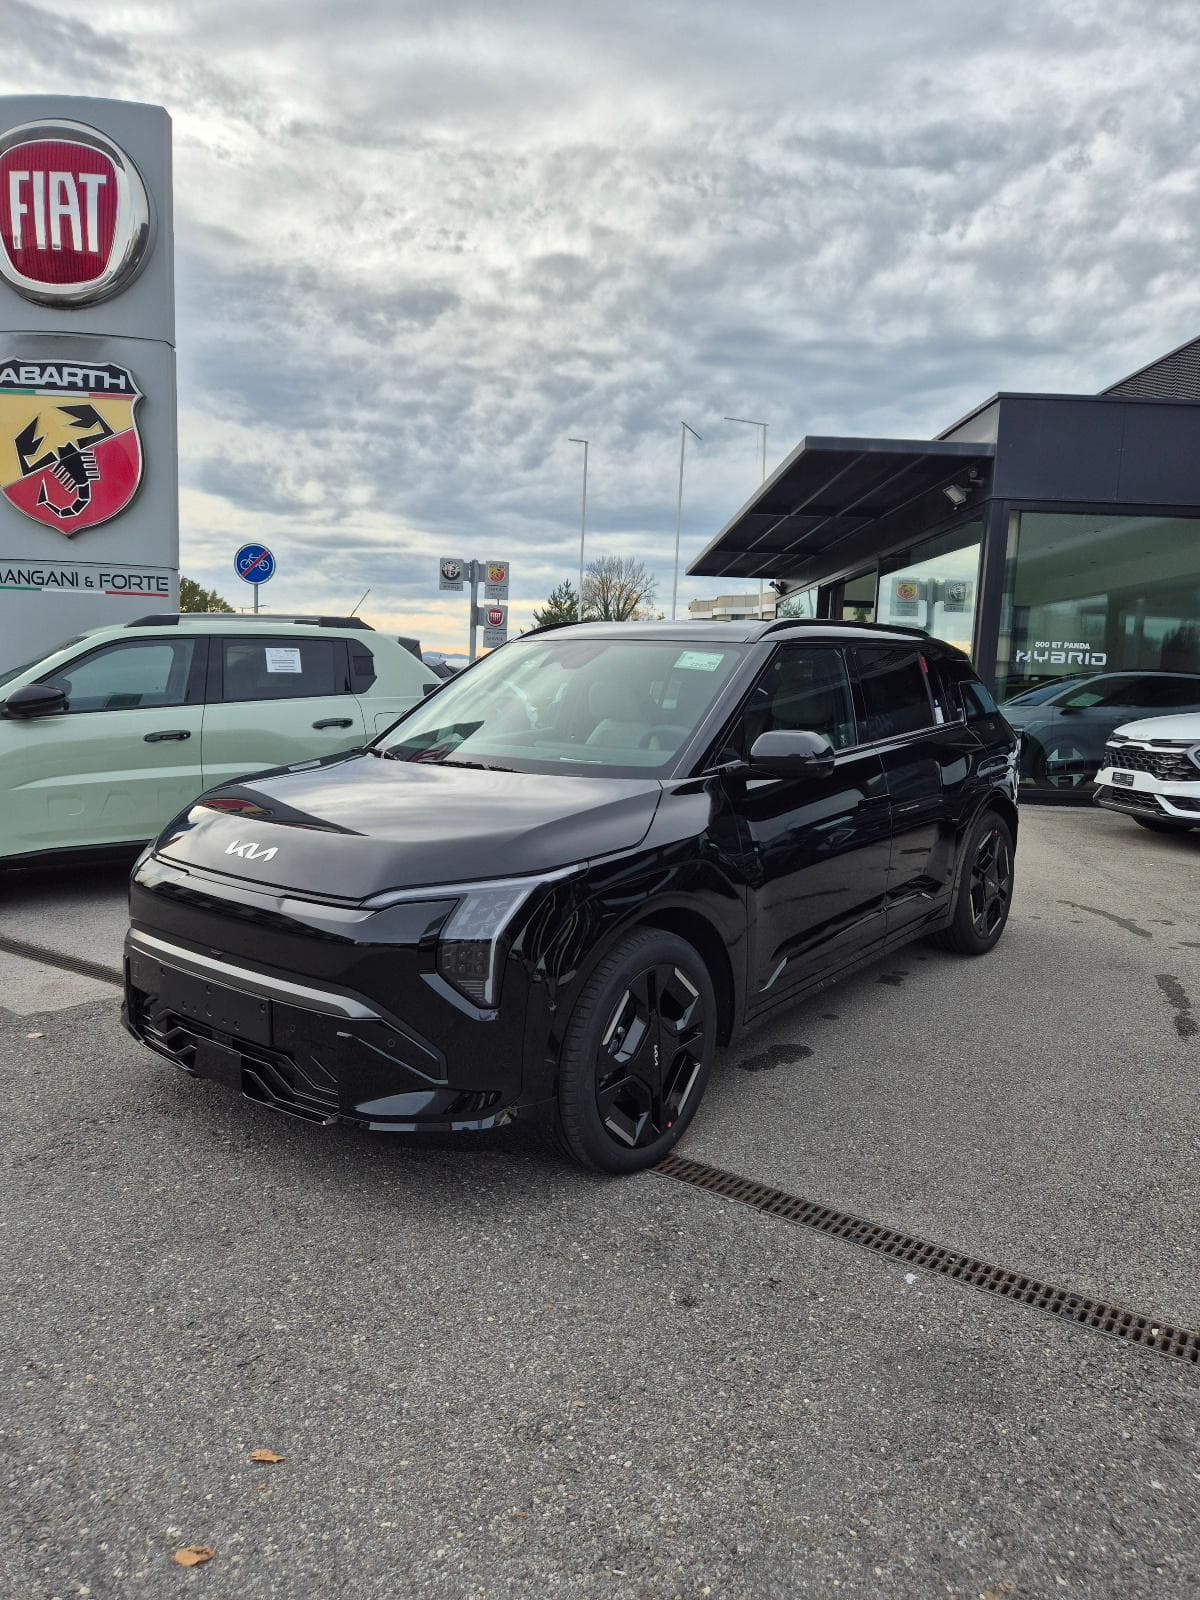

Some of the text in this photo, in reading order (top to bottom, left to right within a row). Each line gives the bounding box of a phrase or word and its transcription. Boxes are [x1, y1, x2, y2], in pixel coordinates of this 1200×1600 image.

[9, 170, 108, 253] FIAT
[0, 366, 126, 389] ABARTH
[0, 569, 169, 592] ANGANI & FORTE
[1015, 650, 1107, 665] HYBRID
[224, 839, 279, 862] KIA
